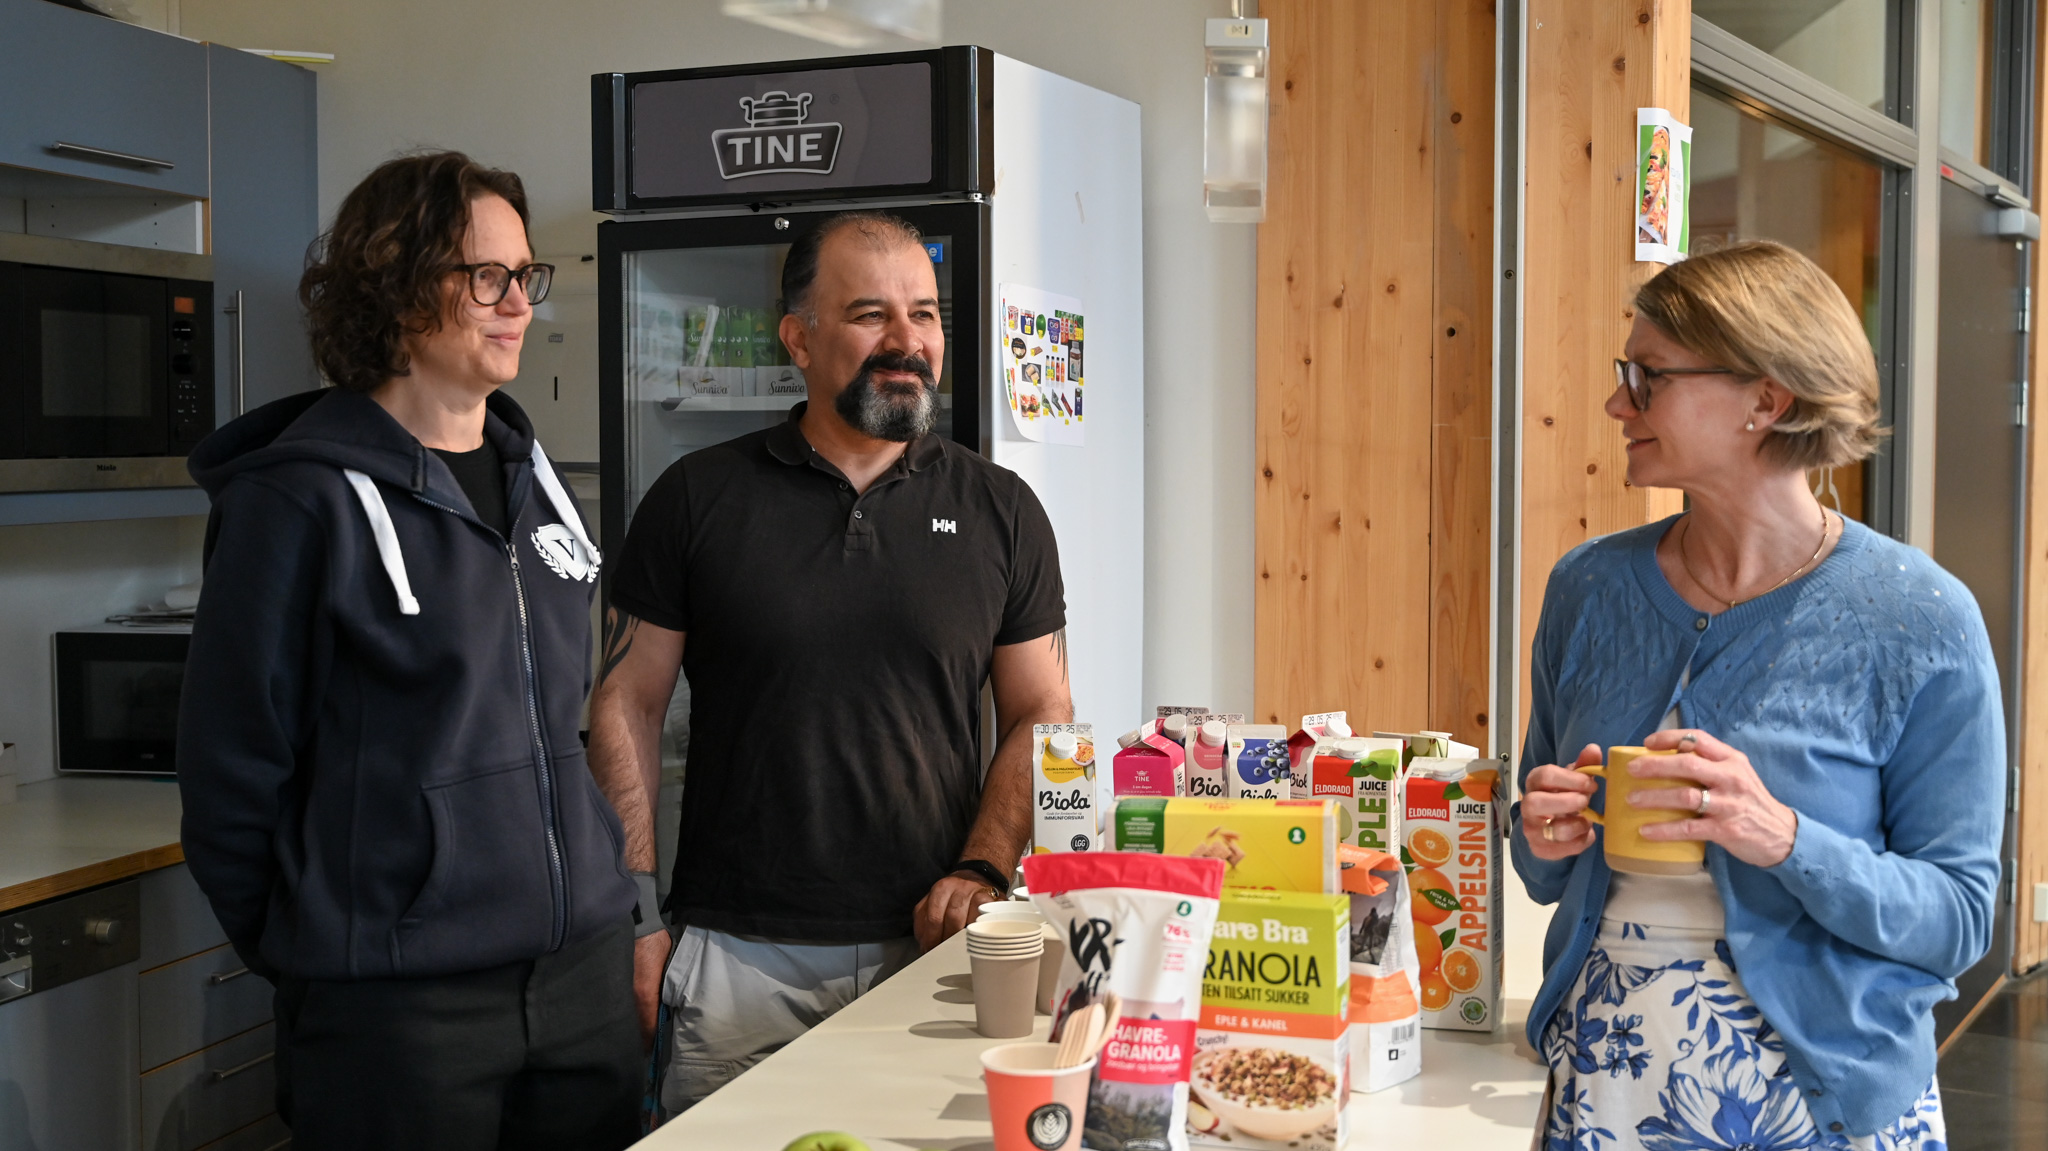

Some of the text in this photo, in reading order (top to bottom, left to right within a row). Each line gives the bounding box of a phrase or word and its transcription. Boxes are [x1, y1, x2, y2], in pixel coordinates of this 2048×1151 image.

[727, 133, 823, 166] TINE
[692, 381, 729, 395] Sunniva
[932, 518, 957, 534] HH
[550, 538, 576, 562] V
[1163, 706, 1172, 716] 29
[1193, 715, 1203, 726] 29
[1217, 714, 1227, 724] 25
[1308, 715, 1315, 726] 29
[1317, 714, 1324, 725] 05
[1040, 724, 1050, 734] 30
[1052, 724, 1062, 734] 05
[1065, 724, 1076, 734] 25
[1190, 776, 1222, 797] Bio
[1290, 772, 1308, 788] Biol
[1358, 780, 1387, 791] JUICE
[1314, 784, 1351, 795] ELDORADO
[1038, 789, 1091, 811] Biola
[1408, 807, 1447, 819] ELDORADO
[1455, 803, 1486, 814] JUICE
[1358, 798, 1387, 853] PLE
[1074, 839, 1086, 848] LGG
[1458, 821, 1488, 952] APPELSIN
[1434, 898, 1448, 908] SMAK
[1212, 918, 1309, 945] are Bra
[1203, 948, 1321, 988] RANOLA
[1201, 983, 1310, 1005] TEN TILSATT SUKKER
[1215, 1013, 1288, 1032] EPLE & KANEL
[1111, 1024, 1168, 1044] HAVRE-
[1107, 1041, 1181, 1062] GRANOLA
